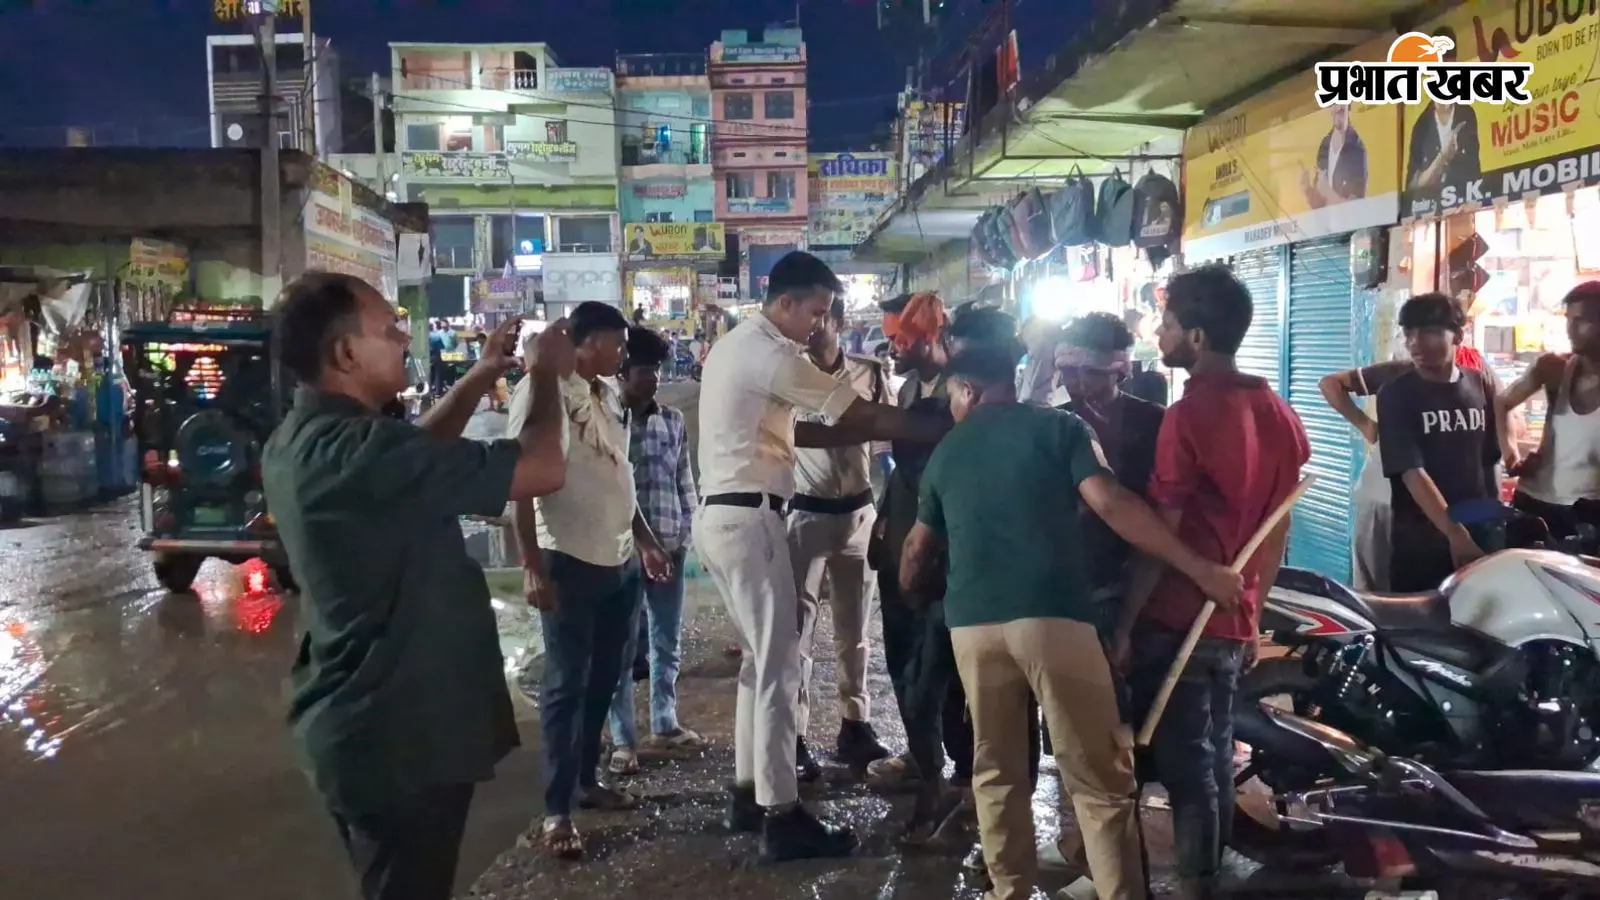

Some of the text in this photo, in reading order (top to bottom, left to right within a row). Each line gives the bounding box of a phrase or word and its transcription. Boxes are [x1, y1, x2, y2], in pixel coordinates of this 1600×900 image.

[1537, 40, 1559, 61] BORN
[1561, 34, 1572, 50] TO
[1575, 27, 1586, 47] BE
[1491, 90, 1580, 148] MUSIC
[1441, 178, 1491, 207] S.K.
